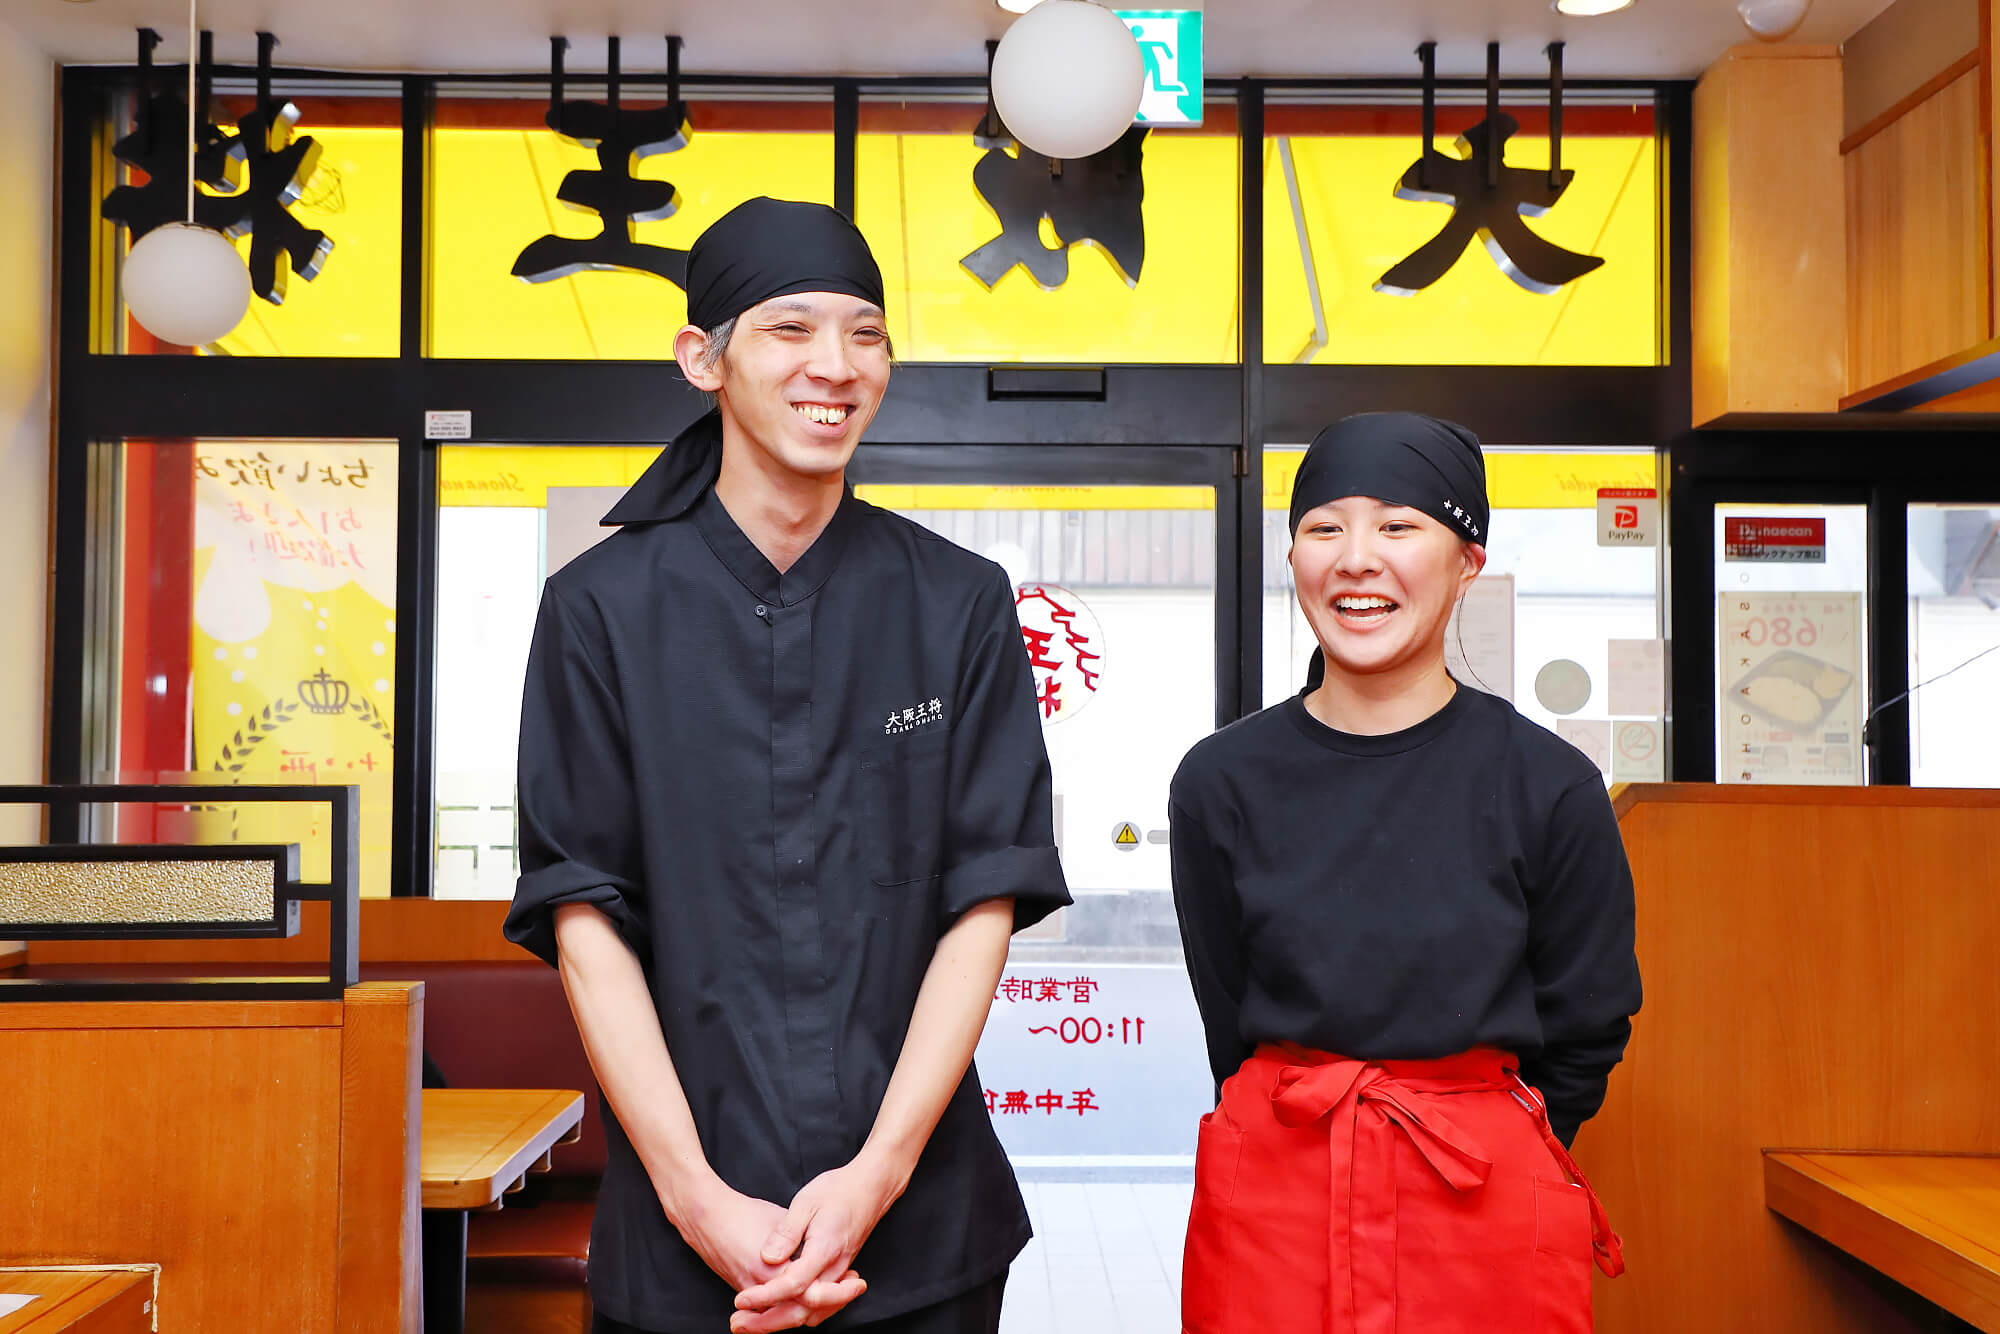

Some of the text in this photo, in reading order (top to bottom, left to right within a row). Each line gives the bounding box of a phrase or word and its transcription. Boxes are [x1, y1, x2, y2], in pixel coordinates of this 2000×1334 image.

[1608, 530, 1645, 542] PayPay
[884, 697, 943, 729] 大阪王将
[885, 713, 943, 735] OSAKA OHSHO
